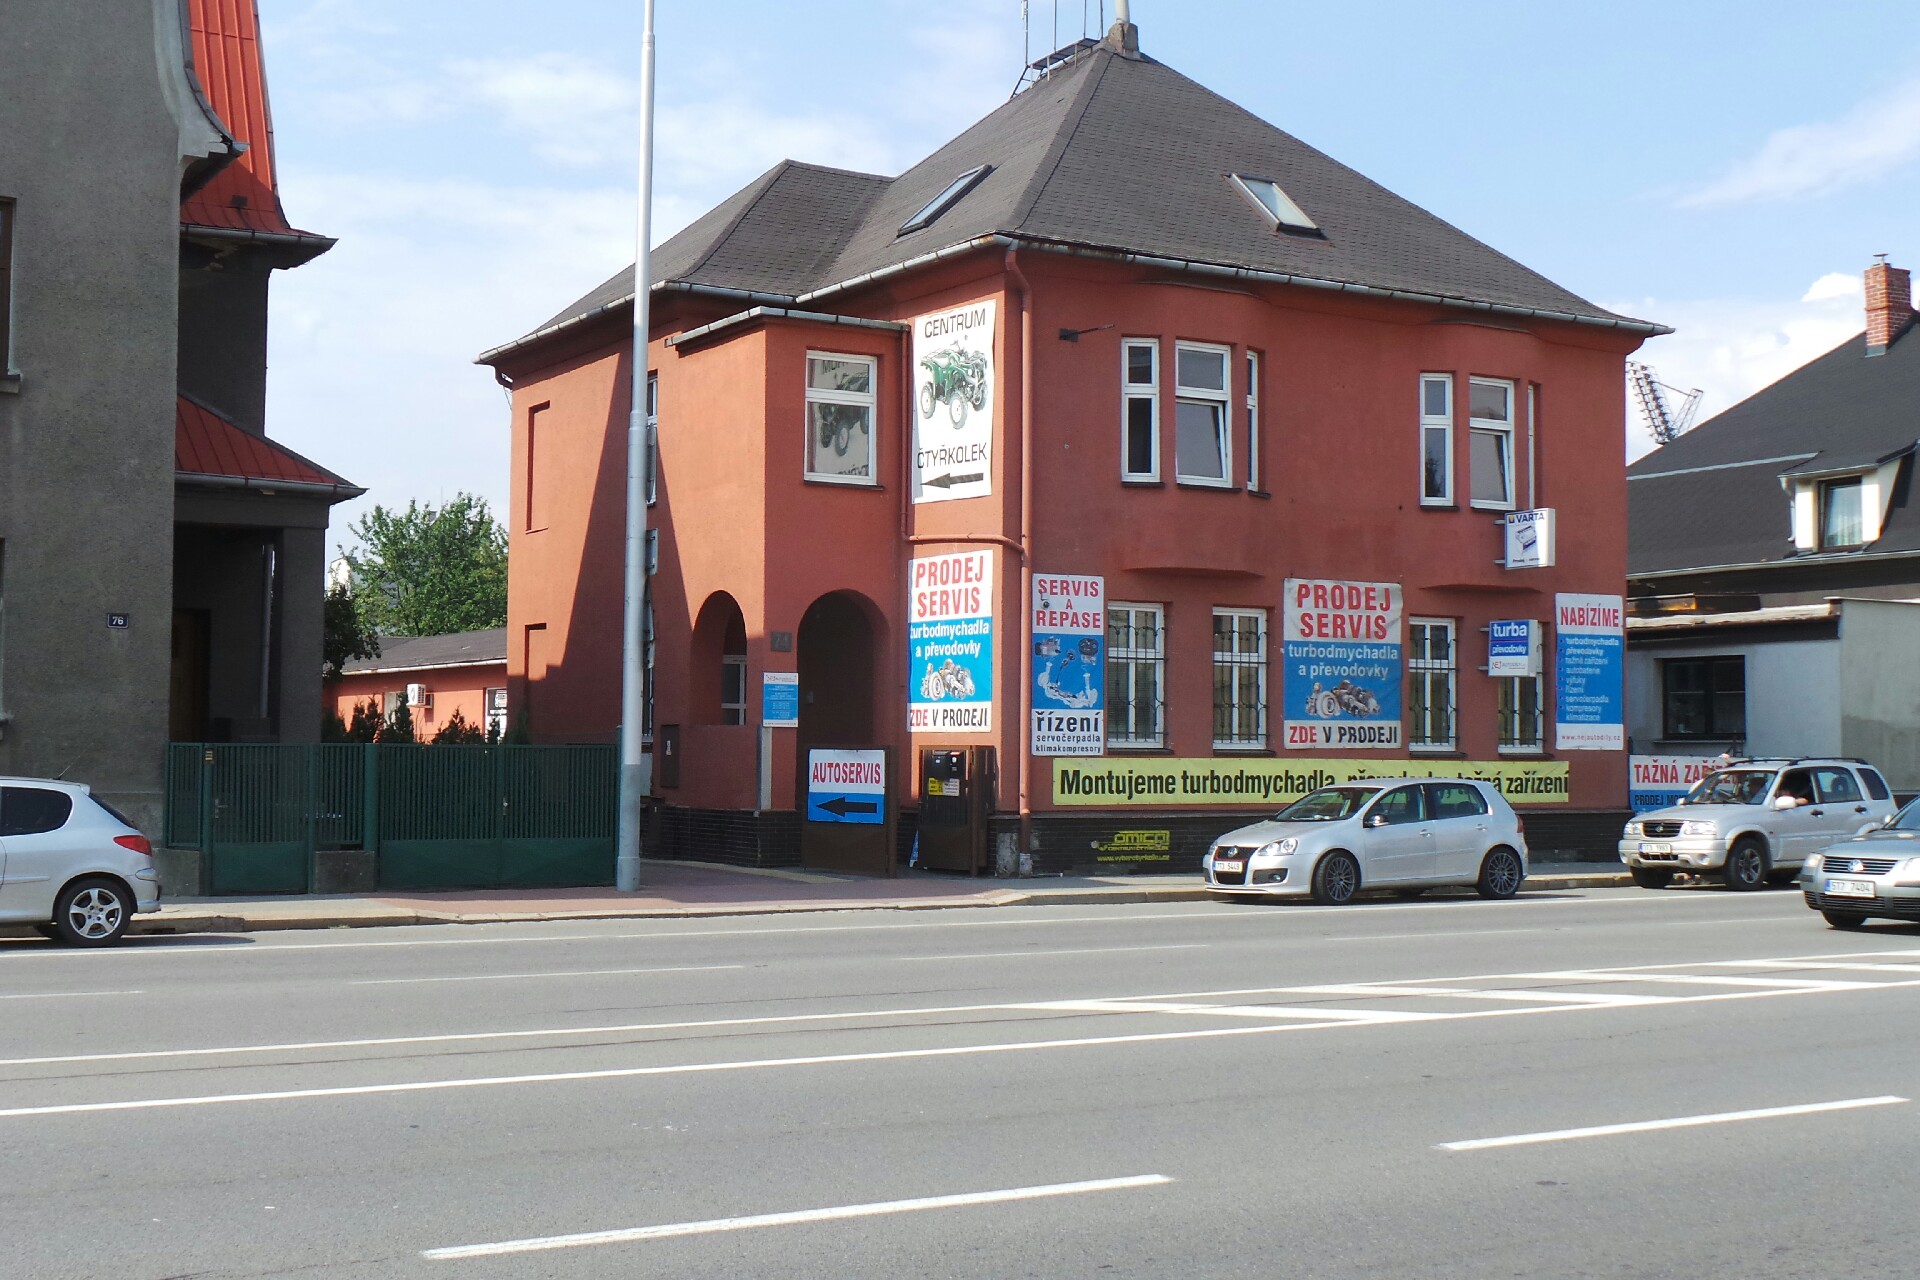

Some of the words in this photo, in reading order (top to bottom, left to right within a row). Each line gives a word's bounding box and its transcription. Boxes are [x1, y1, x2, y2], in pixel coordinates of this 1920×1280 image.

[924, 308, 986, 338] CENTRUM
[917, 442, 988, 469] ČTYŘKOLEK
[1516, 512, 1545, 523] VARTA
[915, 555, 984, 588] PRODEJ
[1037, 579, 1099, 597] SERVIS
[917, 586, 980, 618] SERVIS
[1065, 599, 1073, 610] A
[1297, 584, 1391, 612] PRODEJ
[112, 616, 124, 625] 76
[1036, 610, 1101, 629] REPASE
[1560, 603, 1619, 627] NABÍZÍME
[1300, 612, 1387, 640] SERVIS
[1493, 622, 1528, 637] turba
[915, 645, 922, 658] a
[925, 641, 981, 660] převodovky
[1288, 644, 1398, 662] turbodmychadla
[1298, 664, 1307, 676] a
[1310, 662, 1389, 680] převodovky
[909, 708, 928, 727] ZDE
[932, 708, 939, 727] V
[942, 708, 988, 727] PRODEJI
[1036, 710, 1100, 732] řízení
[1036, 733, 1101, 744] servočerpadla
[1289, 726, 1317, 744] ZDE
[1322, 726, 1332, 744] V
[1338, 726, 1397, 744] PRODEJI
[1035, 744, 1101, 754] klimakompresory
[812, 762, 881, 785] AUTOSERVIS
[1634, 759, 1679, 784] TAŽNÁ
[1060, 769, 1176, 800] Montujeme
[1181, 769, 1336, 799] turbodmychadla
[1505, 769, 1569, 794] zařízení
[1634, 794, 1664, 806] PRODEJ
